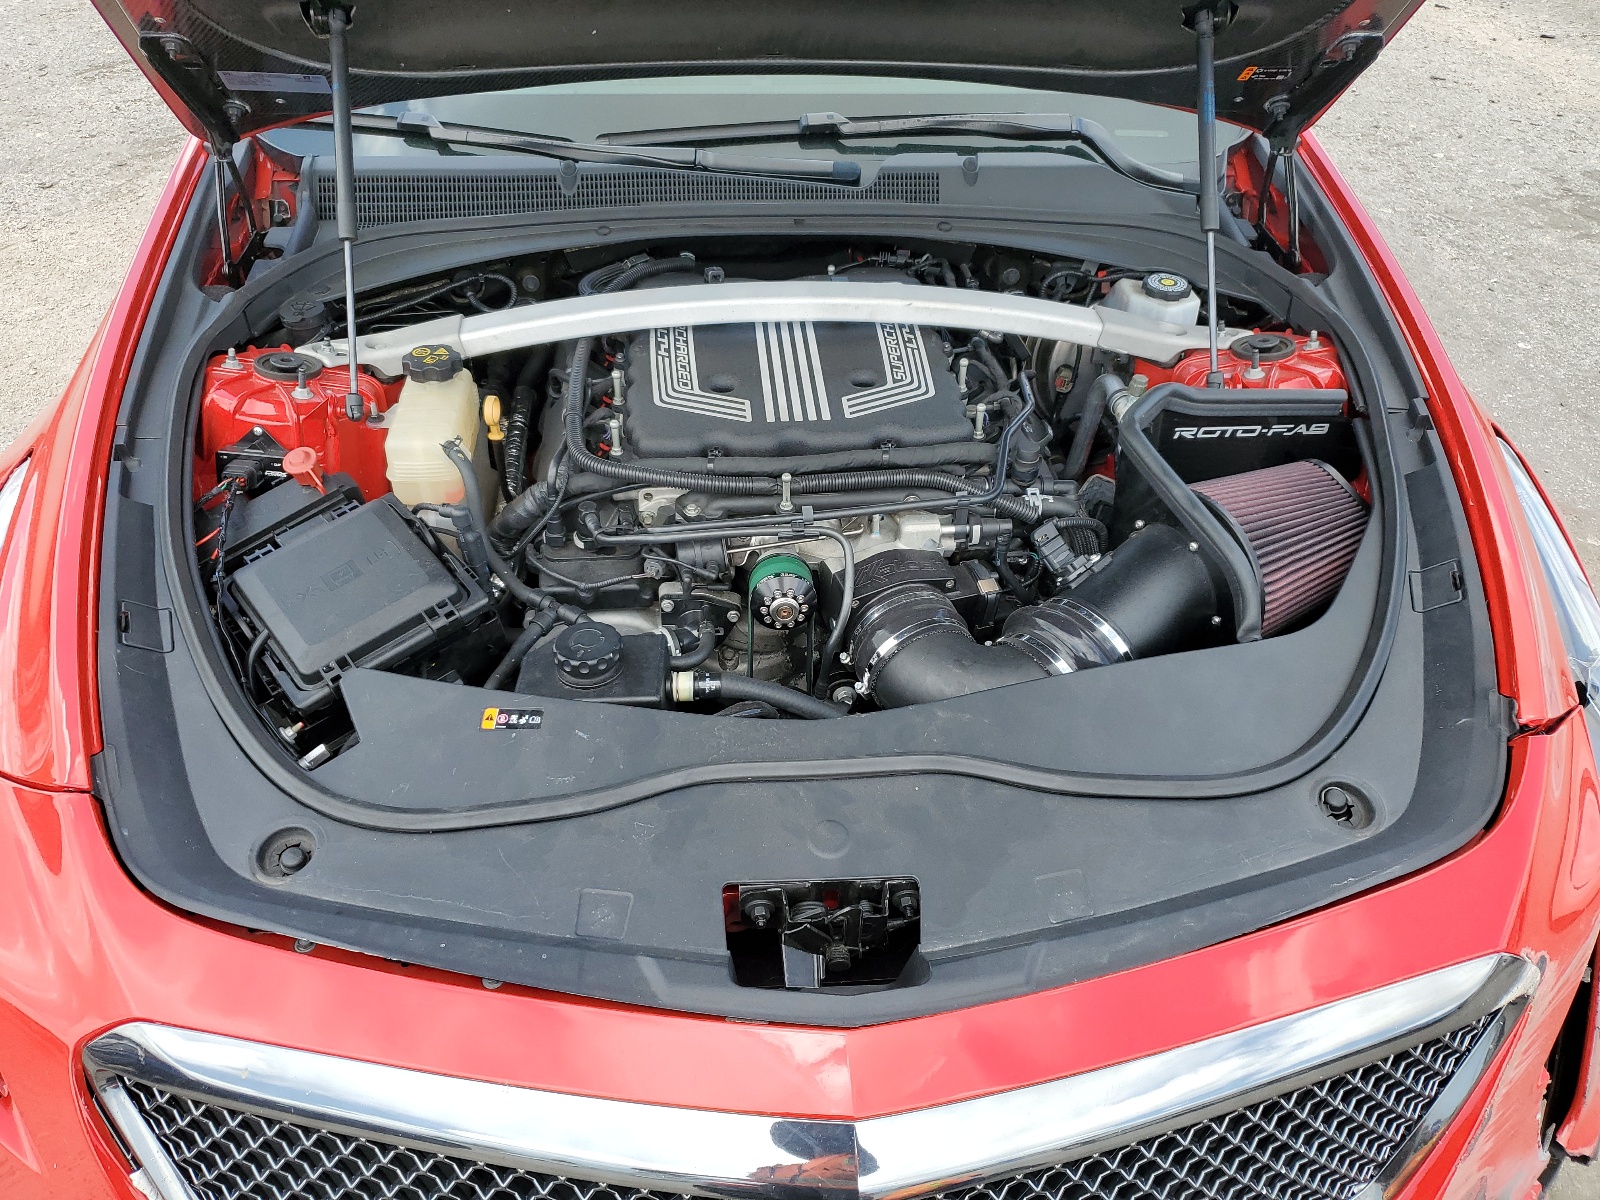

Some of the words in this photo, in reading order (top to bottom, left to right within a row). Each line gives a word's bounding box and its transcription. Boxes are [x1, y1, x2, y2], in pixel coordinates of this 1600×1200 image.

[657, 328, 669, 357] LT4
[882, 323, 906, 380] SUPERCH
[1172, 423, 1330, 440] ROTO-FAB
